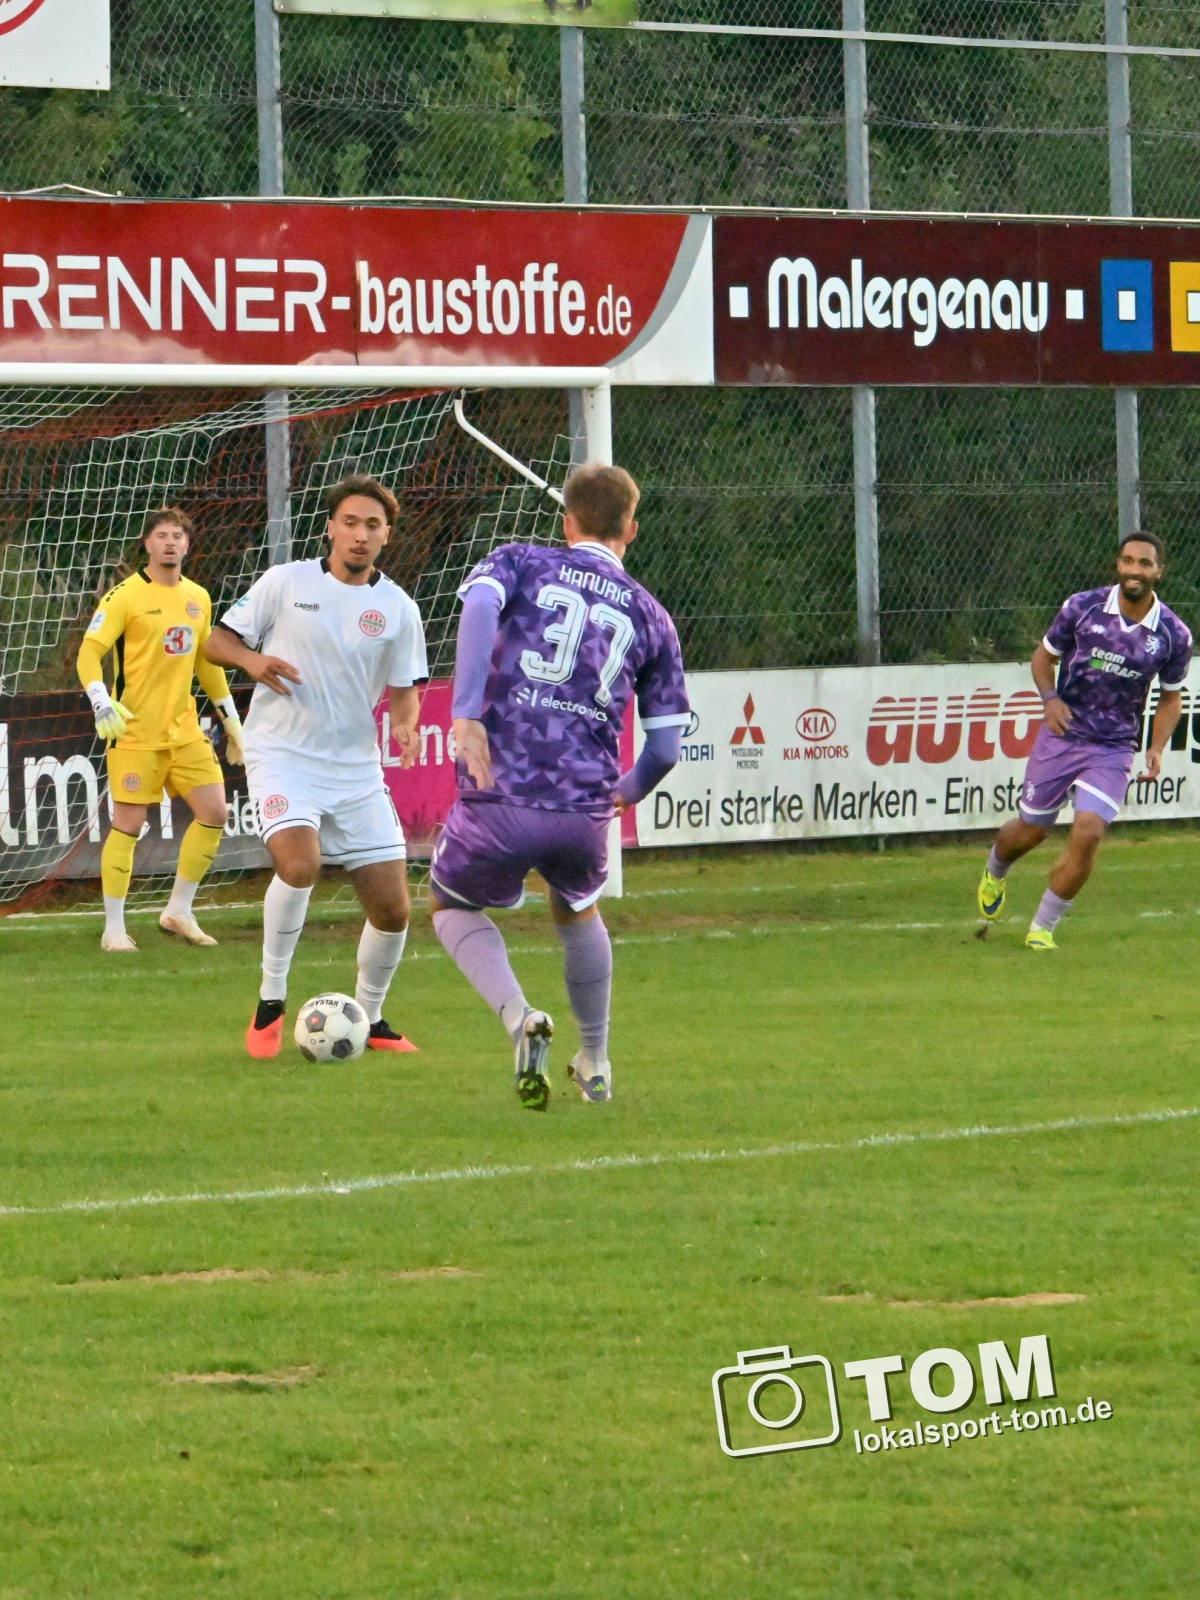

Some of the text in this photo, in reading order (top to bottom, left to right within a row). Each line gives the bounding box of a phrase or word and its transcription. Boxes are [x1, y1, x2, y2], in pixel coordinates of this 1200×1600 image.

[2, 252, 633, 338] RENNER-baustoffe.de
[768, 256, 1049, 348] Malergenau
[519, 584, 636, 708] 37
[1091, 646, 1126, 664] team
[541, 697, 609, 723] electronics
[802, 716, 831, 734] KIA
[732, 748, 764, 758] MITSUBISHI
[783, 747, 801, 761] KIA
[804, 745, 849, 760] MOTORS
[736, 760, 759, 770] MOTORS
[654, 789, 712, 830] Drei
[720, 786, 803, 827] starke
[813, 781, 918, 822] Marken
[944, 776, 984, 816] Ein
